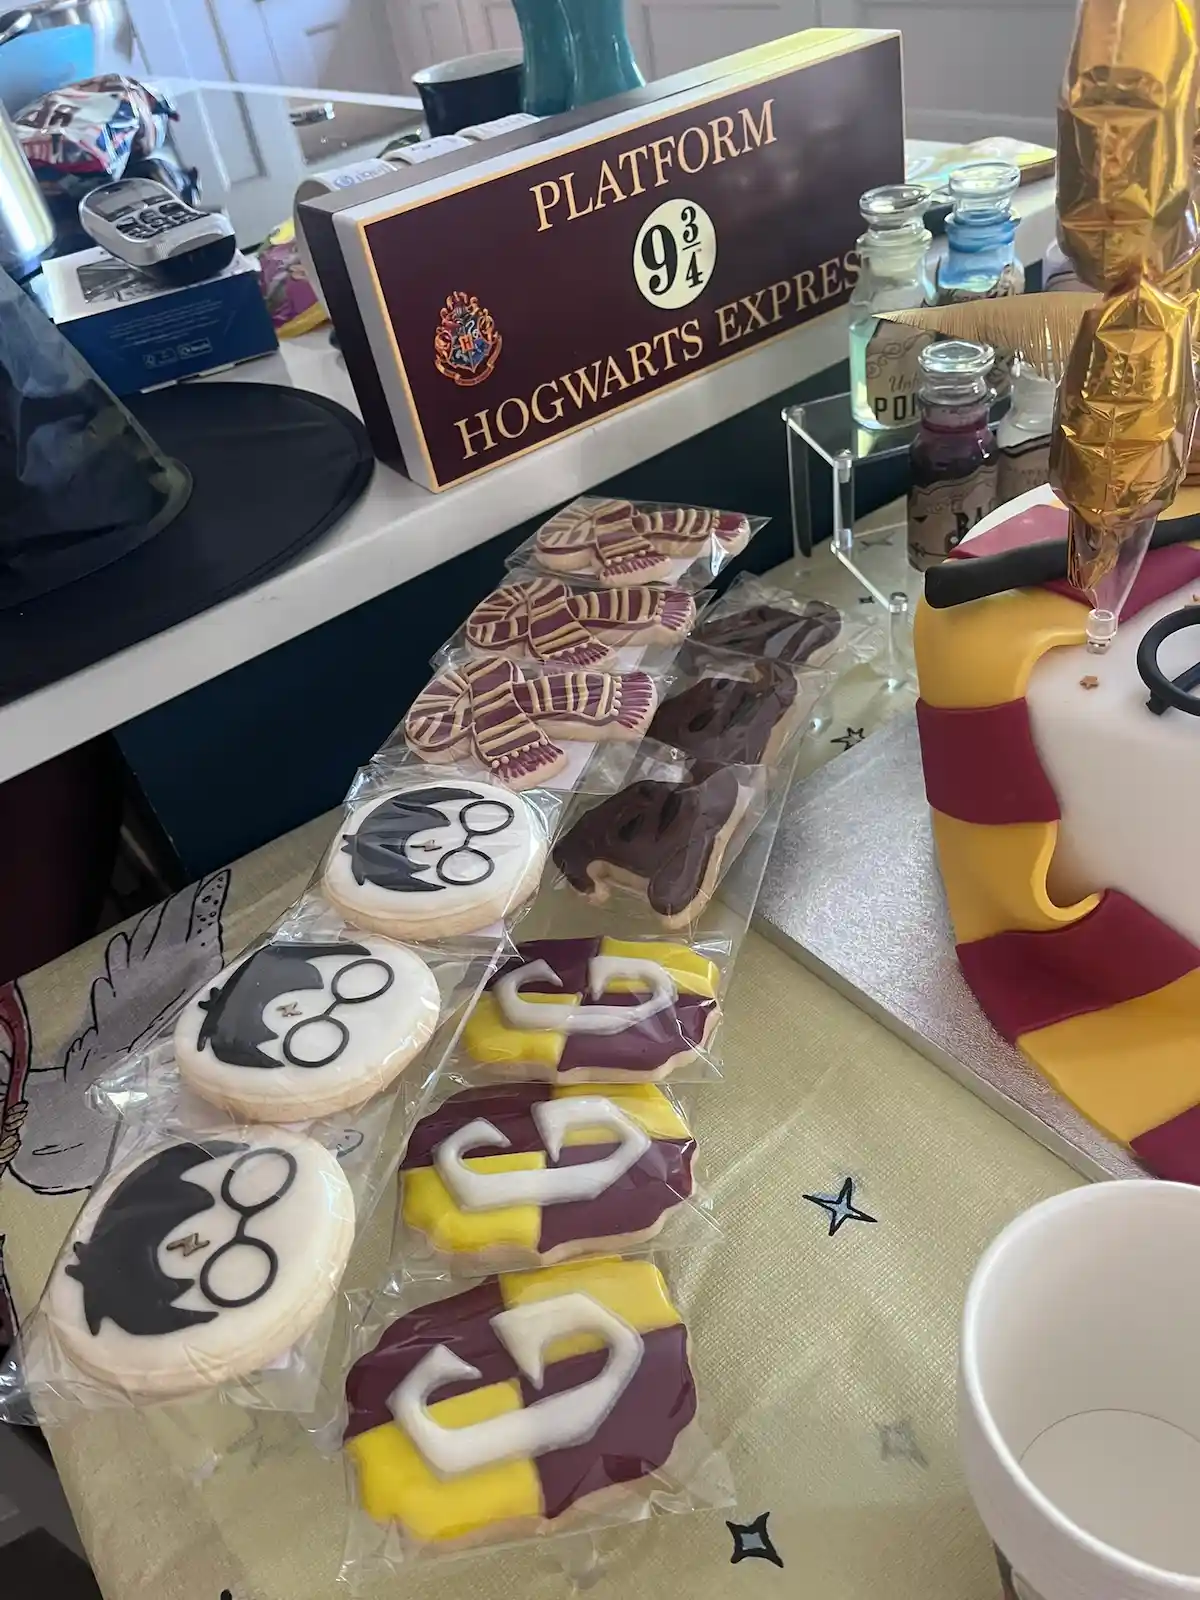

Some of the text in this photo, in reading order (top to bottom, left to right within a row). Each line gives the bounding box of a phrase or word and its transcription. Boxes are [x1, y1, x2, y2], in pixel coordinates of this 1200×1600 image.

[529, 99, 778, 232] PLATFORM
[453, 250, 863, 460] HOGWARTS EXPRES
